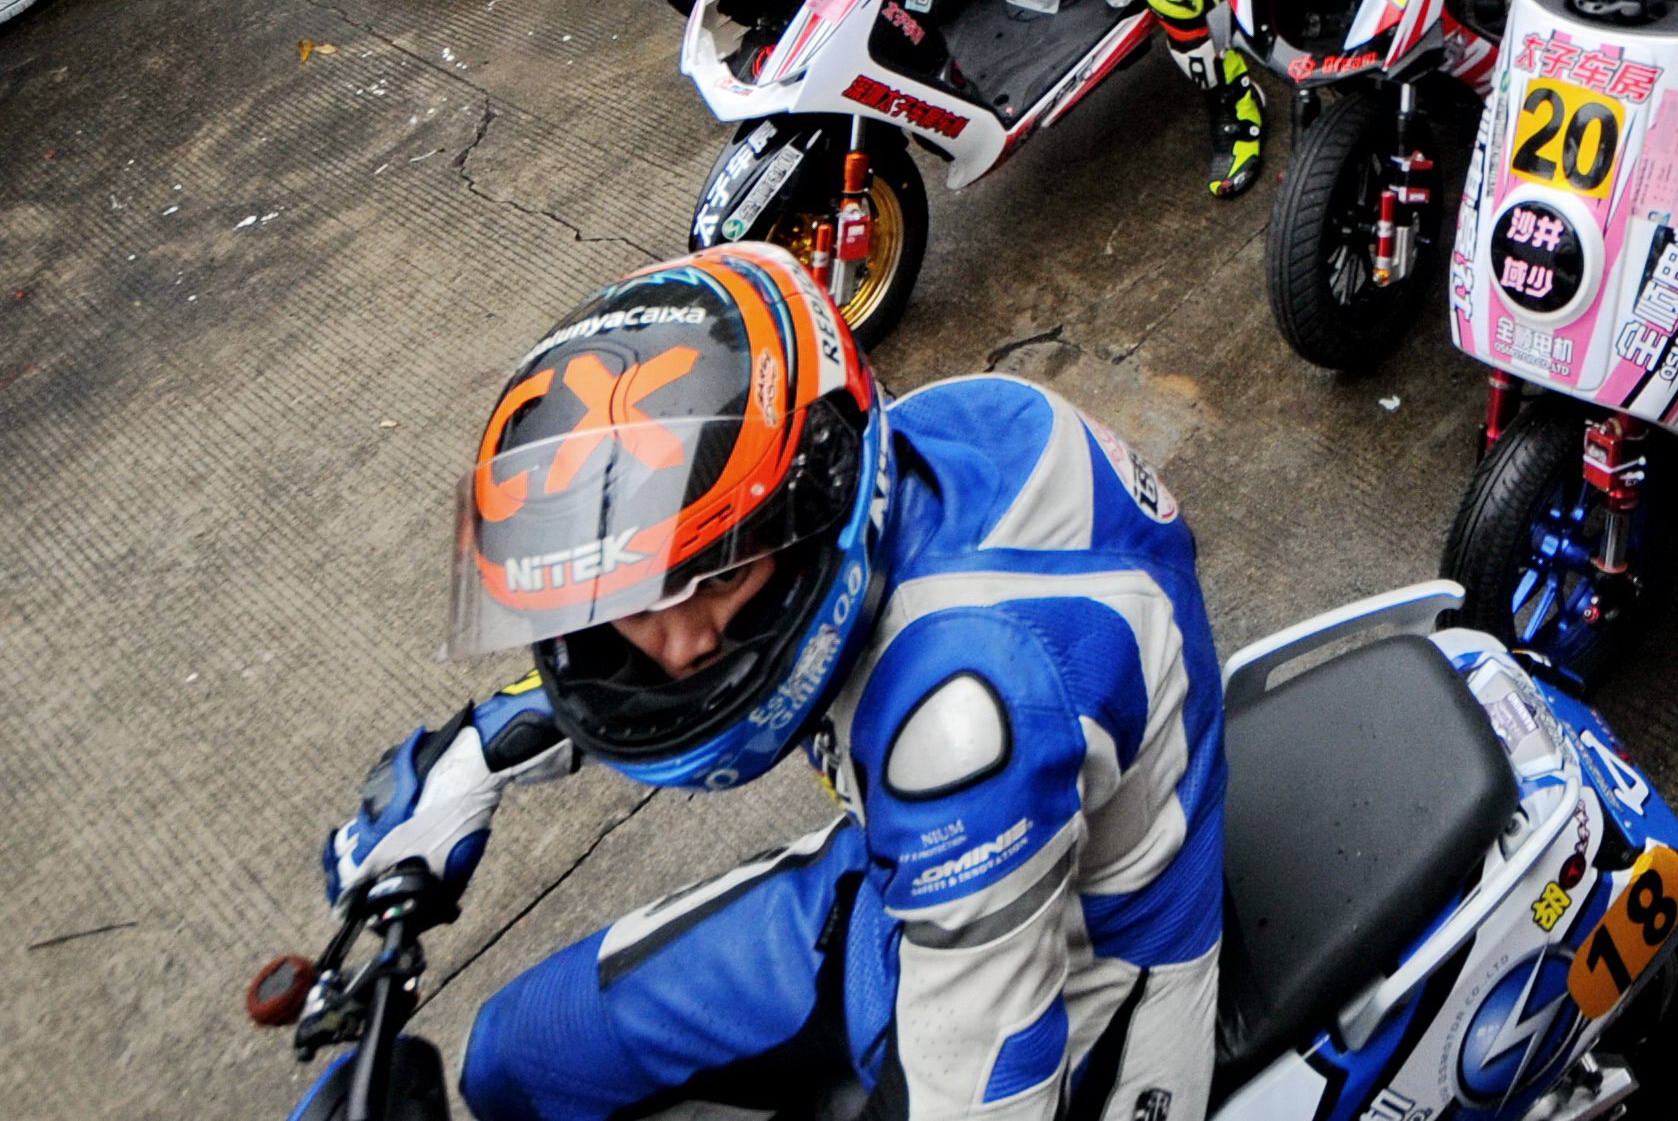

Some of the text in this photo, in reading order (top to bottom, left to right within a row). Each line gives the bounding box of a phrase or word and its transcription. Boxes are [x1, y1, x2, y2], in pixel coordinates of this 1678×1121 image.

[1514, 34, 1663, 105] 太子车房
[1511, 87, 1620, 191] 20
[1506, 207, 1564, 252] 沙井
[1495, 316, 1574, 364] 全顺电机
[1585, 869, 1678, 997] 18
